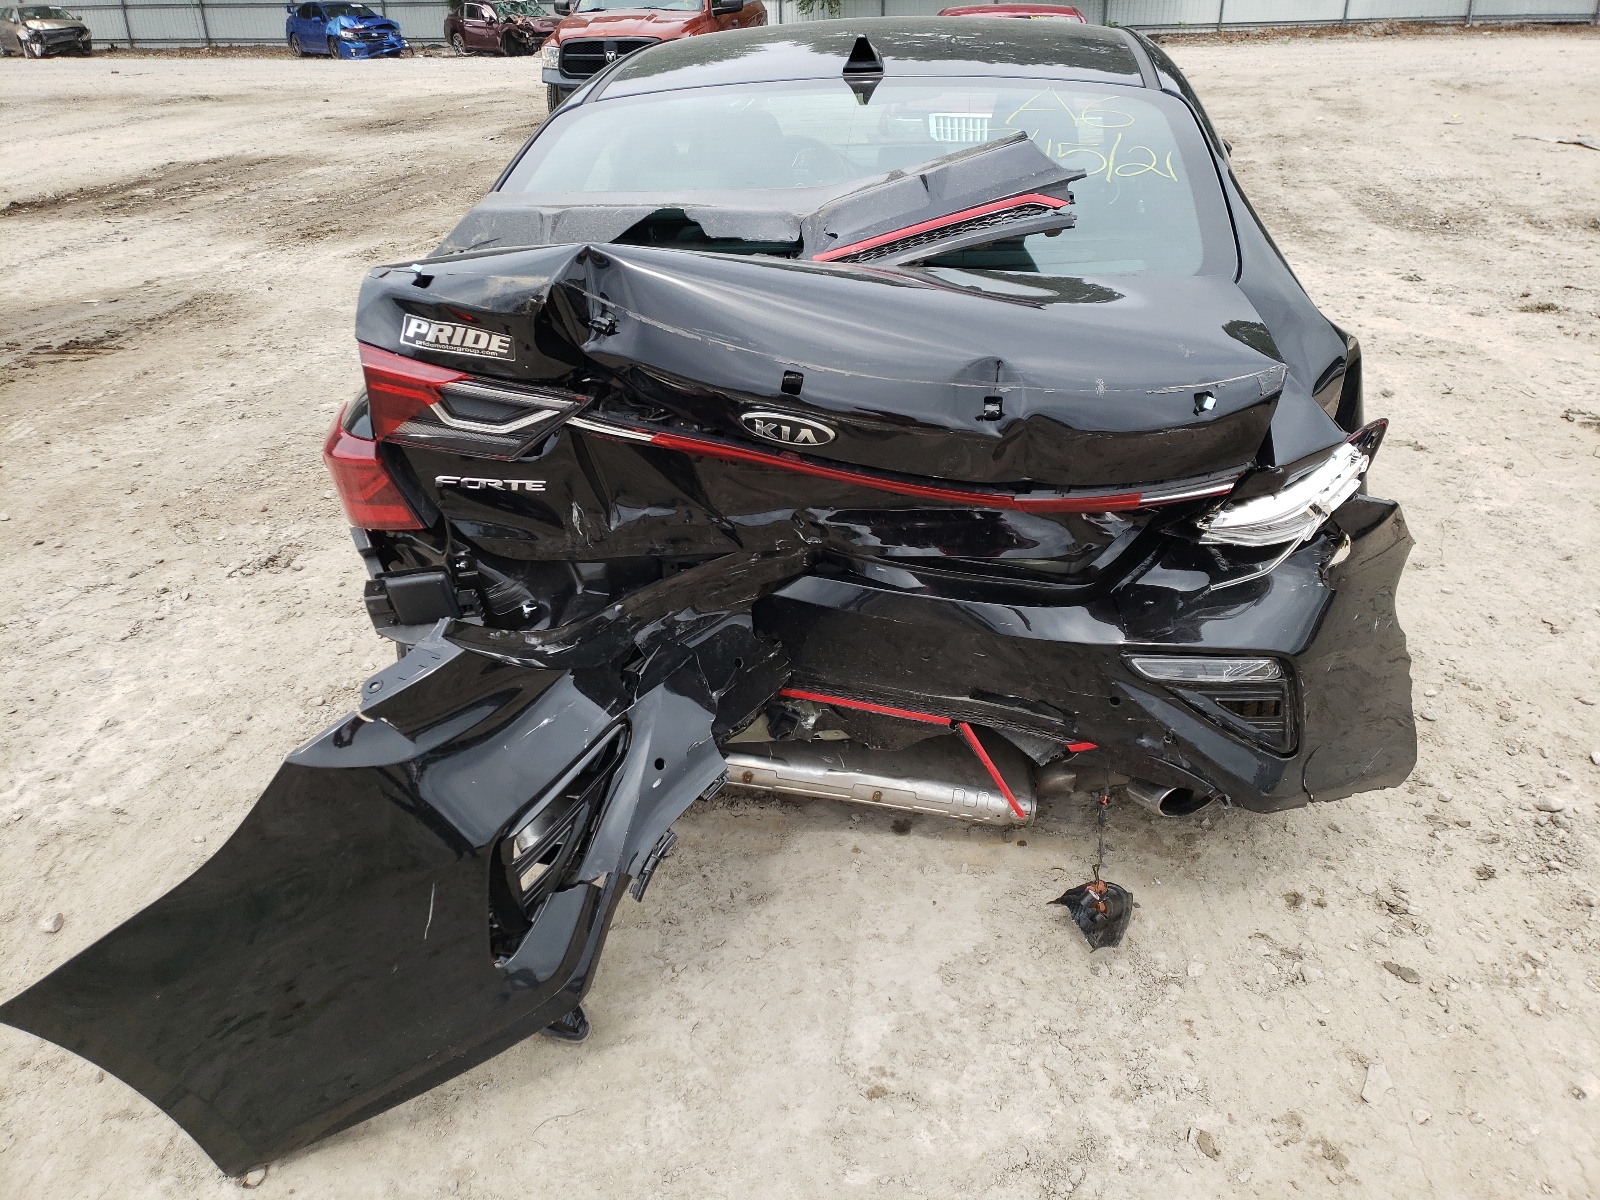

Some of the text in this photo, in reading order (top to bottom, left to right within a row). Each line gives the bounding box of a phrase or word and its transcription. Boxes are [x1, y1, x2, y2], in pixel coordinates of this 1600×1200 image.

[405, 318, 511, 354] PRIDE
[415, 339, 499, 357] pridemotorgroup.com
[754, 418, 818, 444] KIA
[434, 475, 547, 492] FORTE
